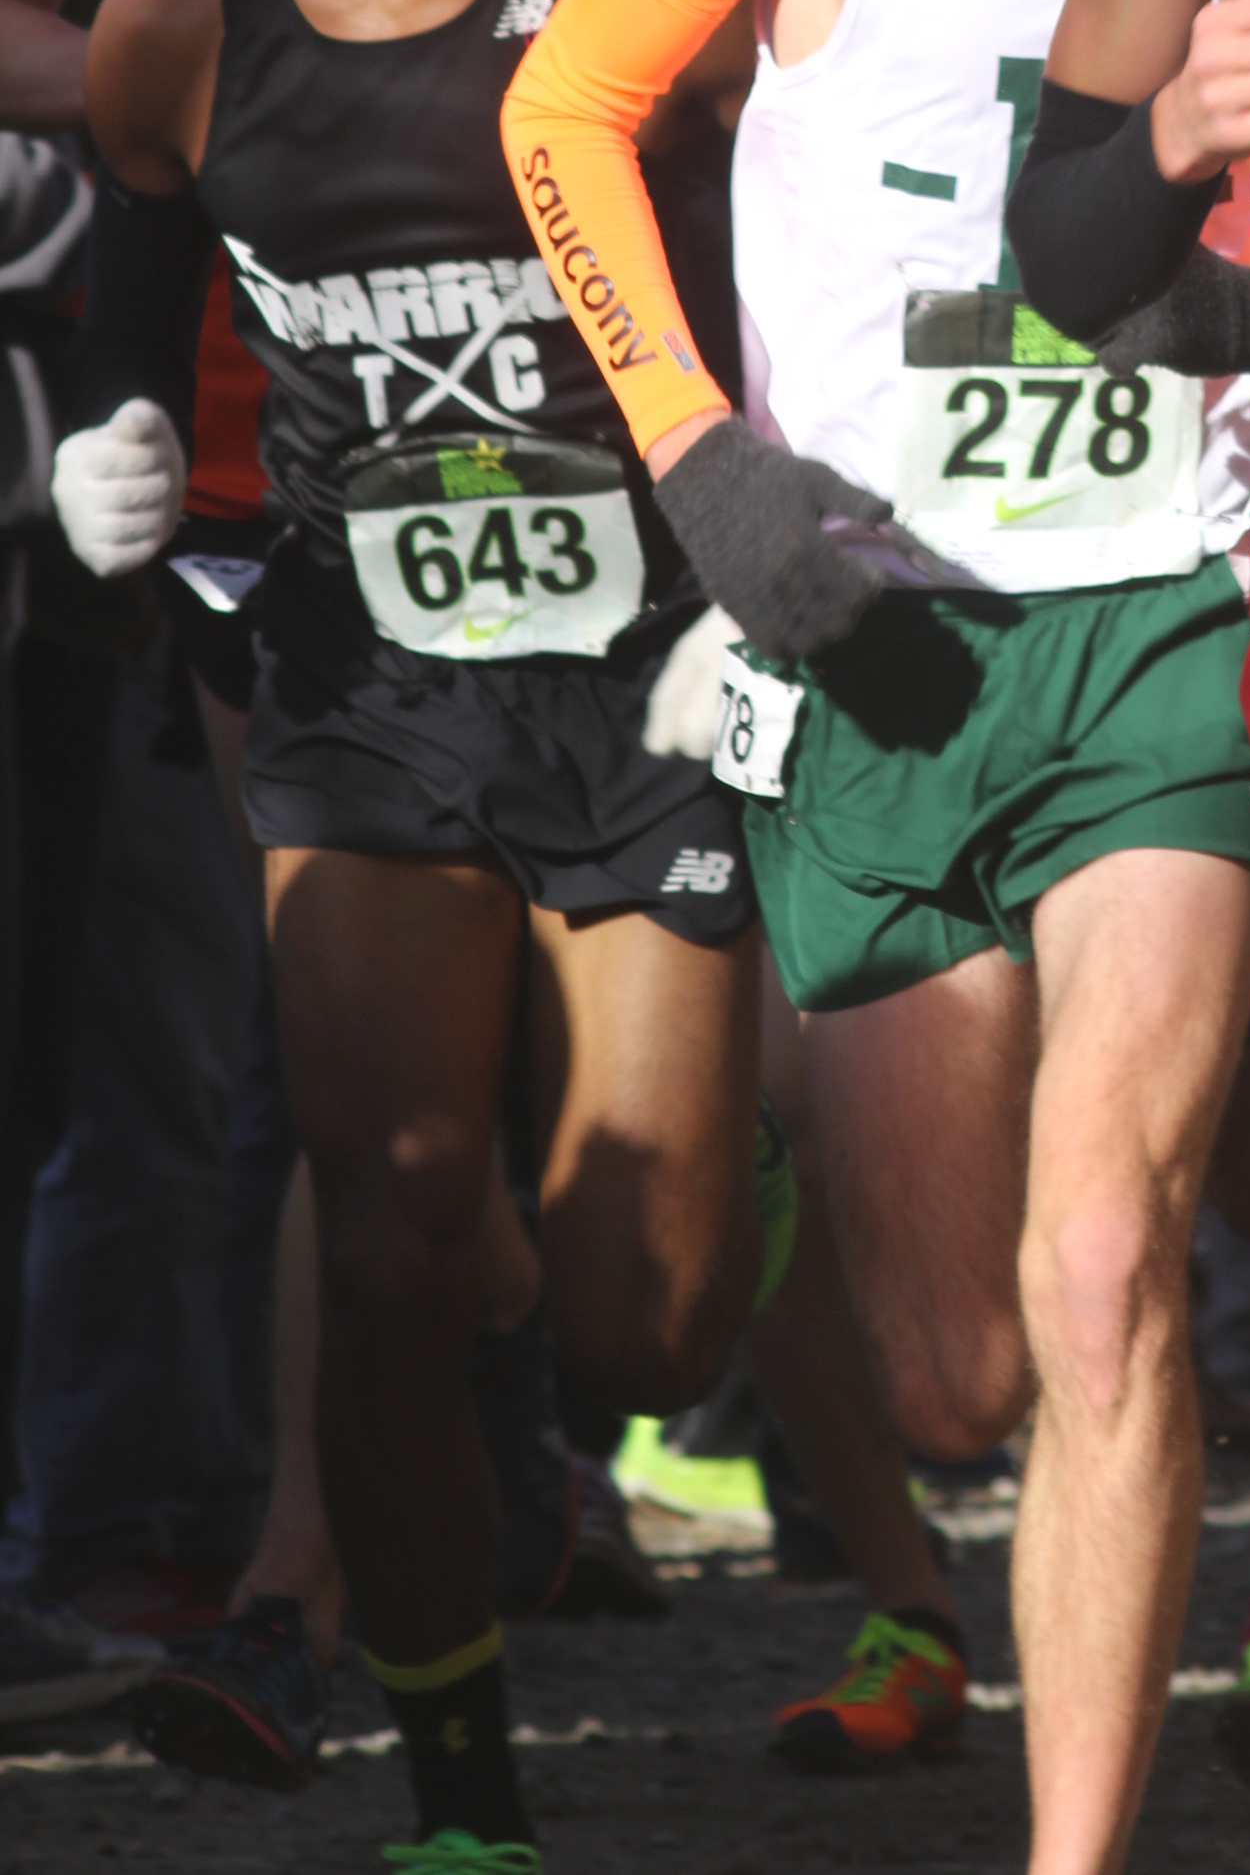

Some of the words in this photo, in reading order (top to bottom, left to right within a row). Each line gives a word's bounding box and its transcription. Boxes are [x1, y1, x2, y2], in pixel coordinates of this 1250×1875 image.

[521, 147, 658, 373] saucony
[942, 375, 1151, 479] 278
[395, 505, 598, 612] 643
[716, 680, 755, 765] 78
